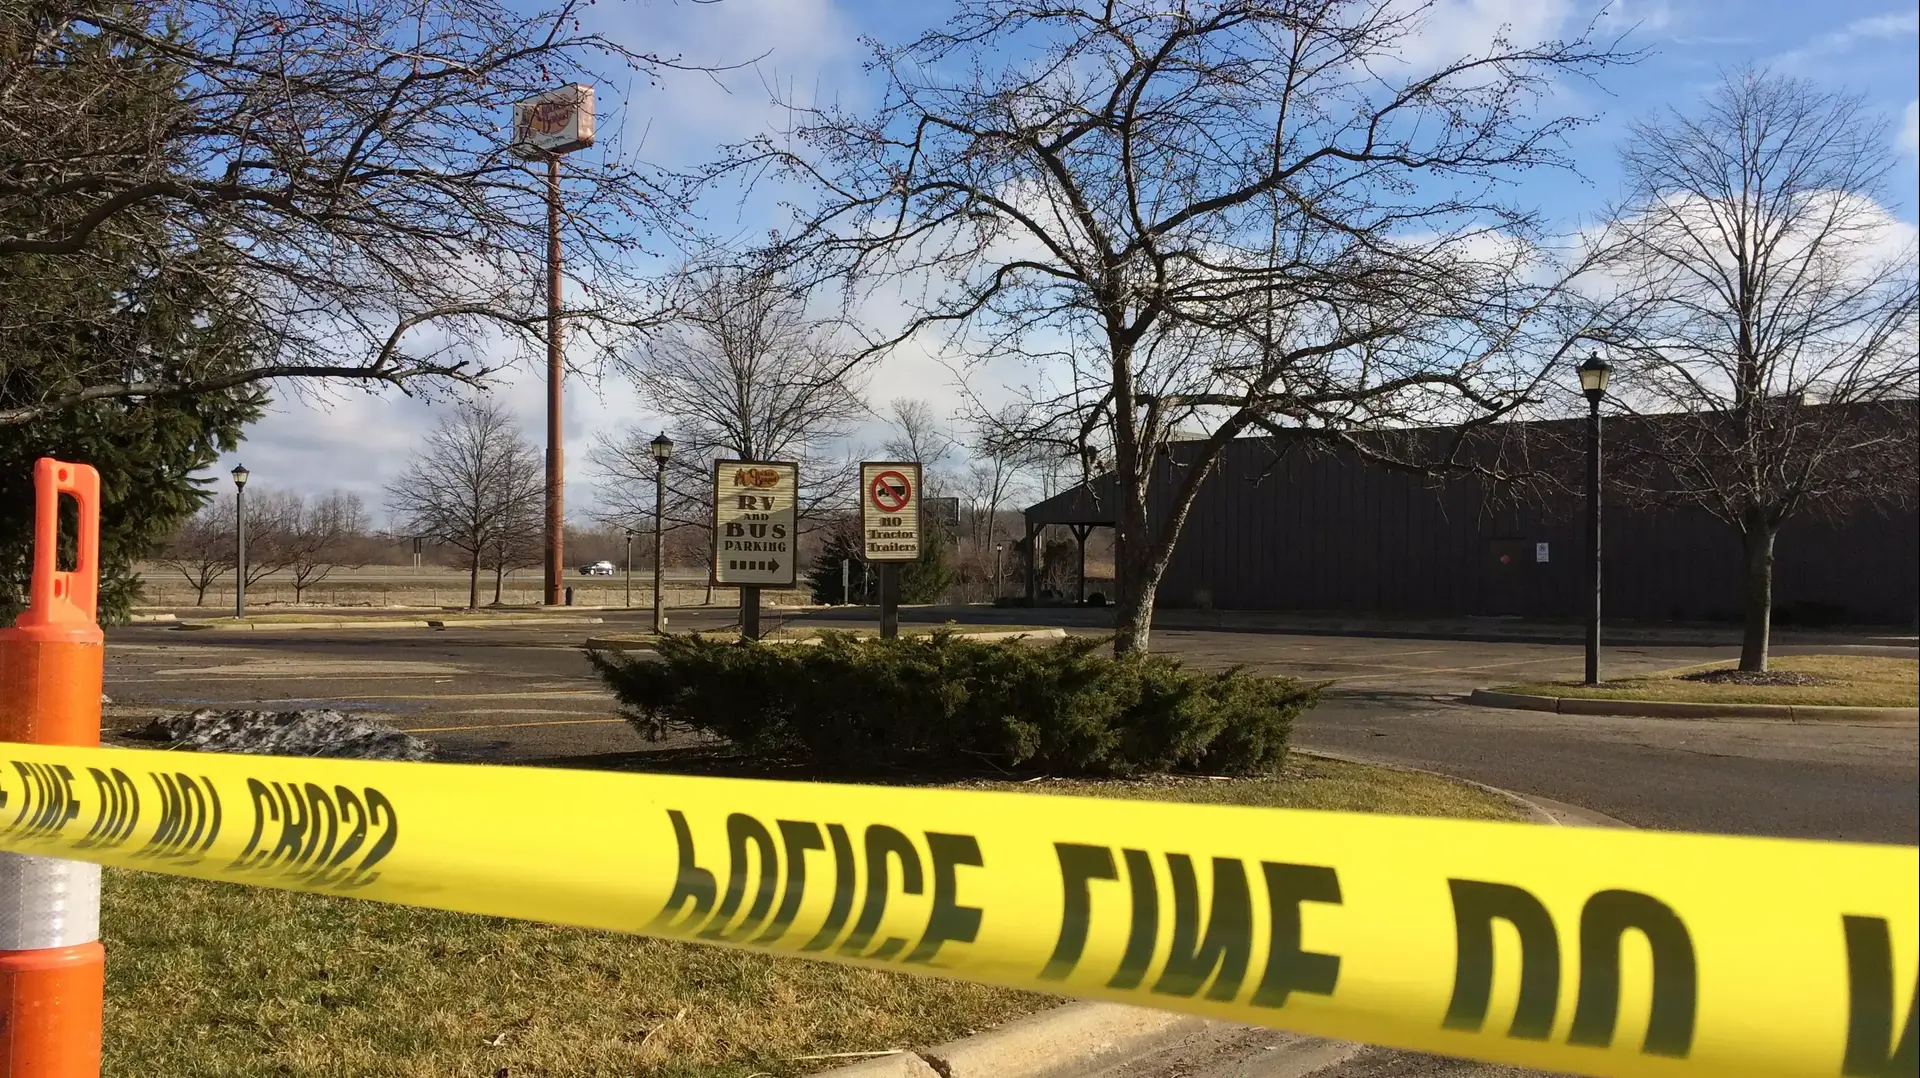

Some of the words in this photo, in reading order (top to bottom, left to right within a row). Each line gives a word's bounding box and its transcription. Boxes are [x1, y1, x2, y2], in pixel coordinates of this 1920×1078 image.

[736, 495, 775, 511] RV
[743, 513, 769, 521] AND
[879, 516, 903, 527] NO
[725, 522, 787, 539] BUS
[867, 529, 915, 539] Tractor
[724, 540, 787, 552] PARKING
[866, 542, 917, 552] Trailers
